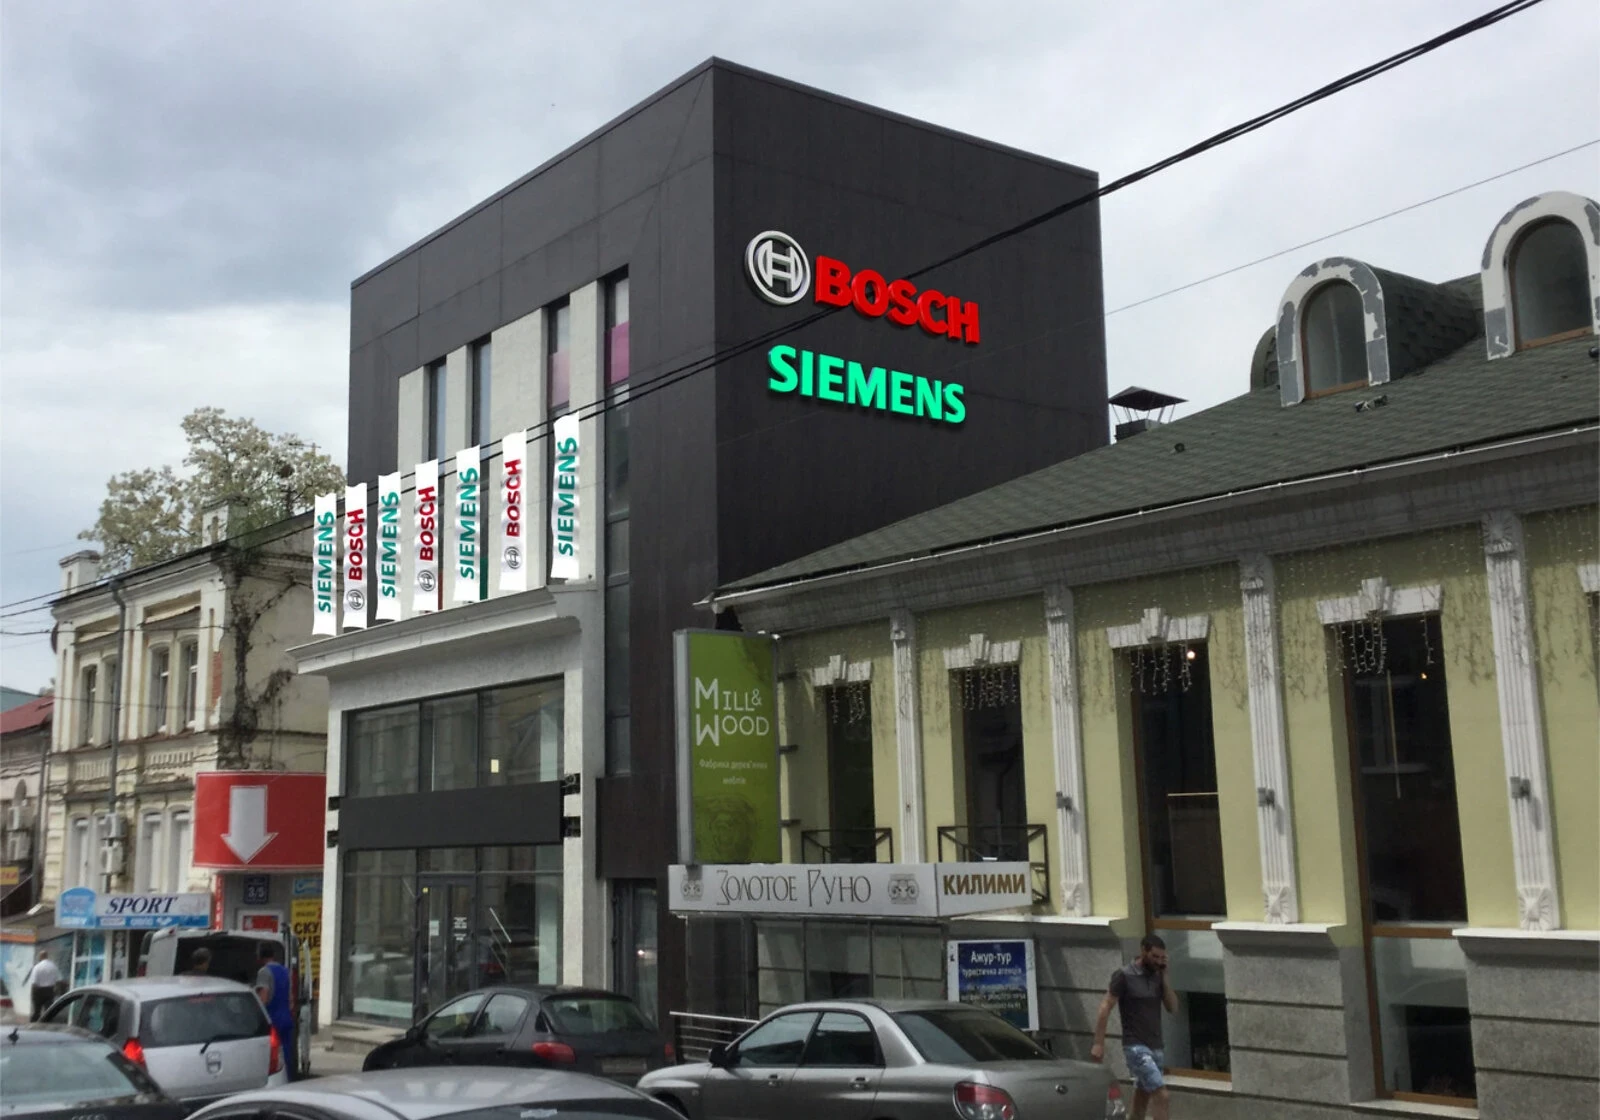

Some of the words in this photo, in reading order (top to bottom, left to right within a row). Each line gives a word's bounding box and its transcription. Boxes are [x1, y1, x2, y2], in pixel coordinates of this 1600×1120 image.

[815, 255, 980, 344] BOSCH
[768, 344, 966, 423] SIEMENS
[418, 485, 436, 561] BOSCH
[459, 467, 478, 580] SIEMENS
[504, 458, 521, 537] BOSCH
[557, 437, 578, 556] SIEMENS
[317, 511, 335, 613] SIEMENS
[346, 508, 365, 581] BOSCH
[381, 491, 399, 598] SIEMENS
[106, 896, 178, 914] SPORT
[943, 873, 1026, 896] КИЛИМИ
[970, 950, 1012, 965] Ажур-тур
